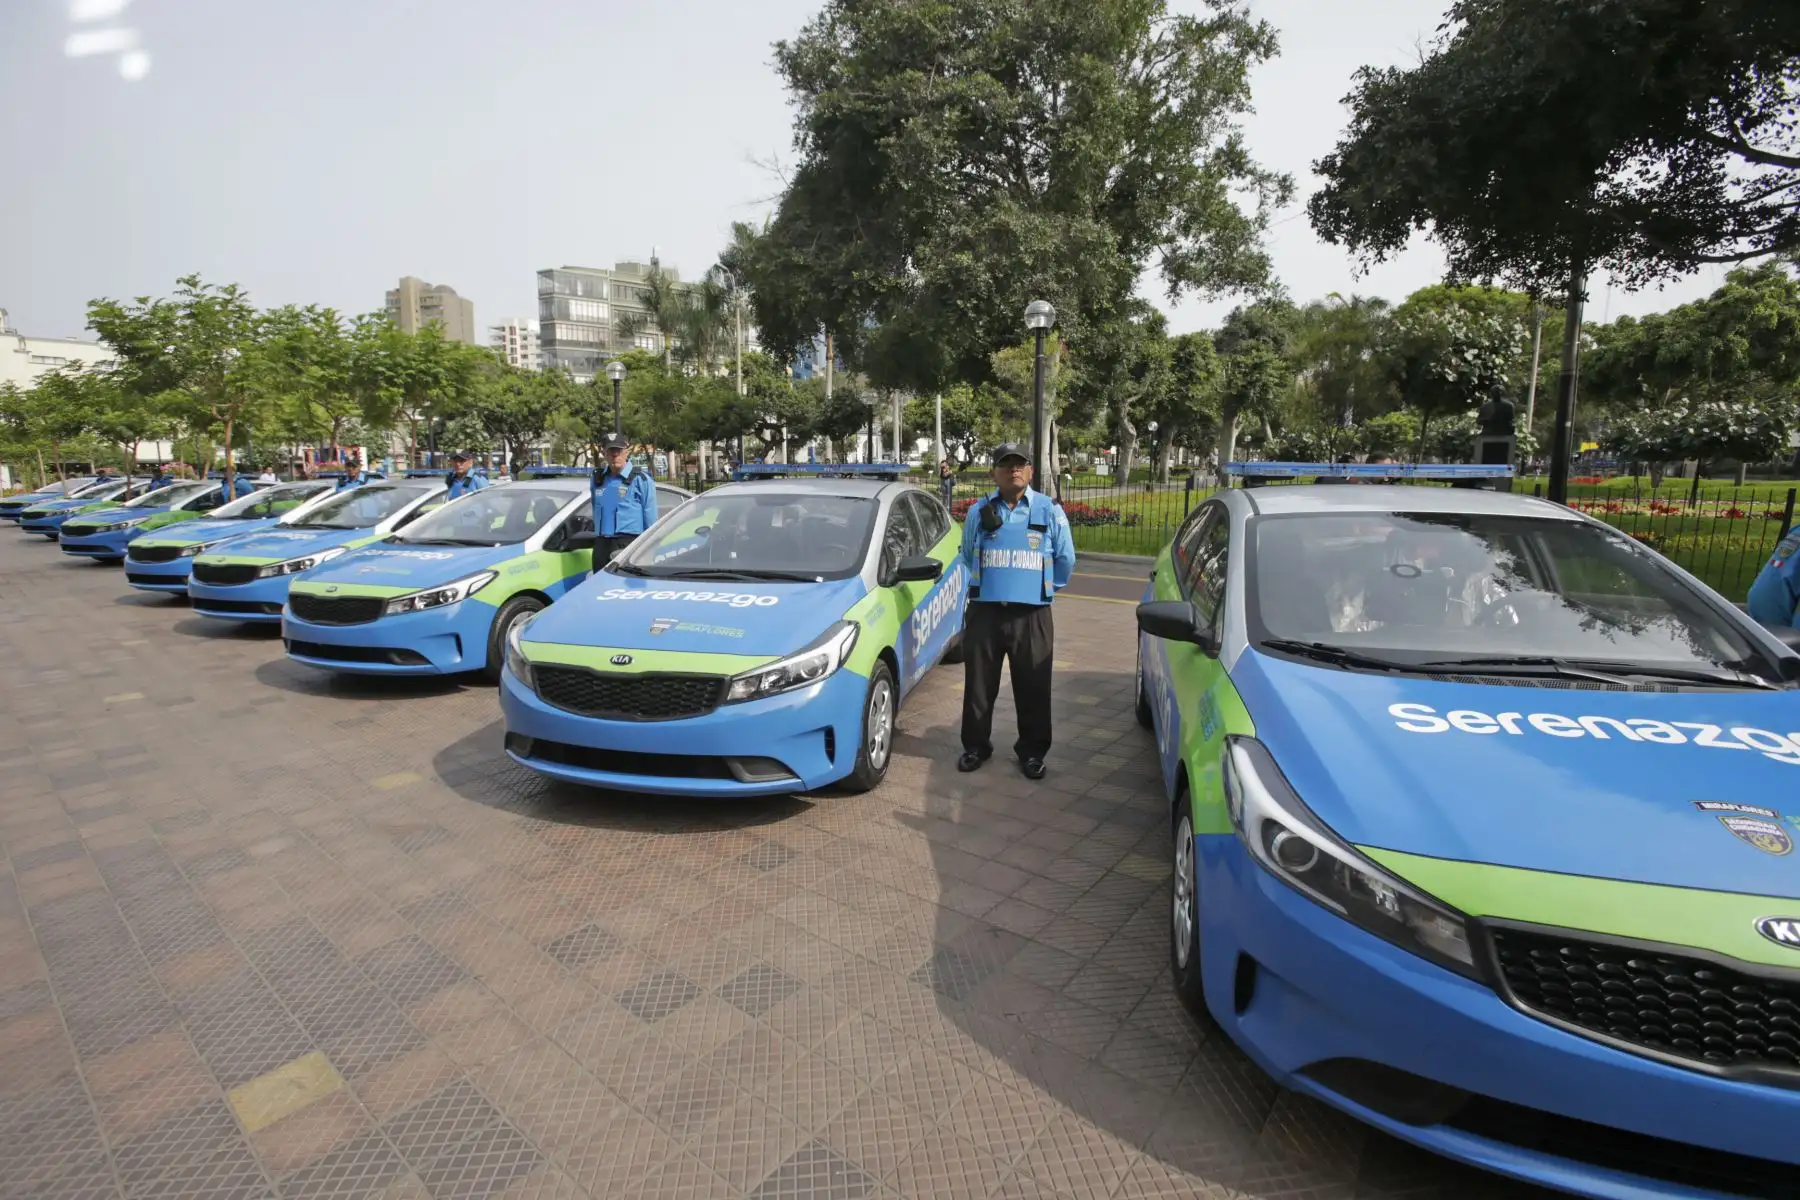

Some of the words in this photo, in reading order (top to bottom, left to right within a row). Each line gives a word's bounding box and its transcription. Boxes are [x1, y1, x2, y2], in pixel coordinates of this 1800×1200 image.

[1012, 550, 1043, 571] CIUDADAN
[597, 588, 779, 608] Serenazgo
[911, 564, 962, 658] Serenazgo
[612, 655, 630, 663] KIA
[1388, 703, 1800, 765] Serenazg
